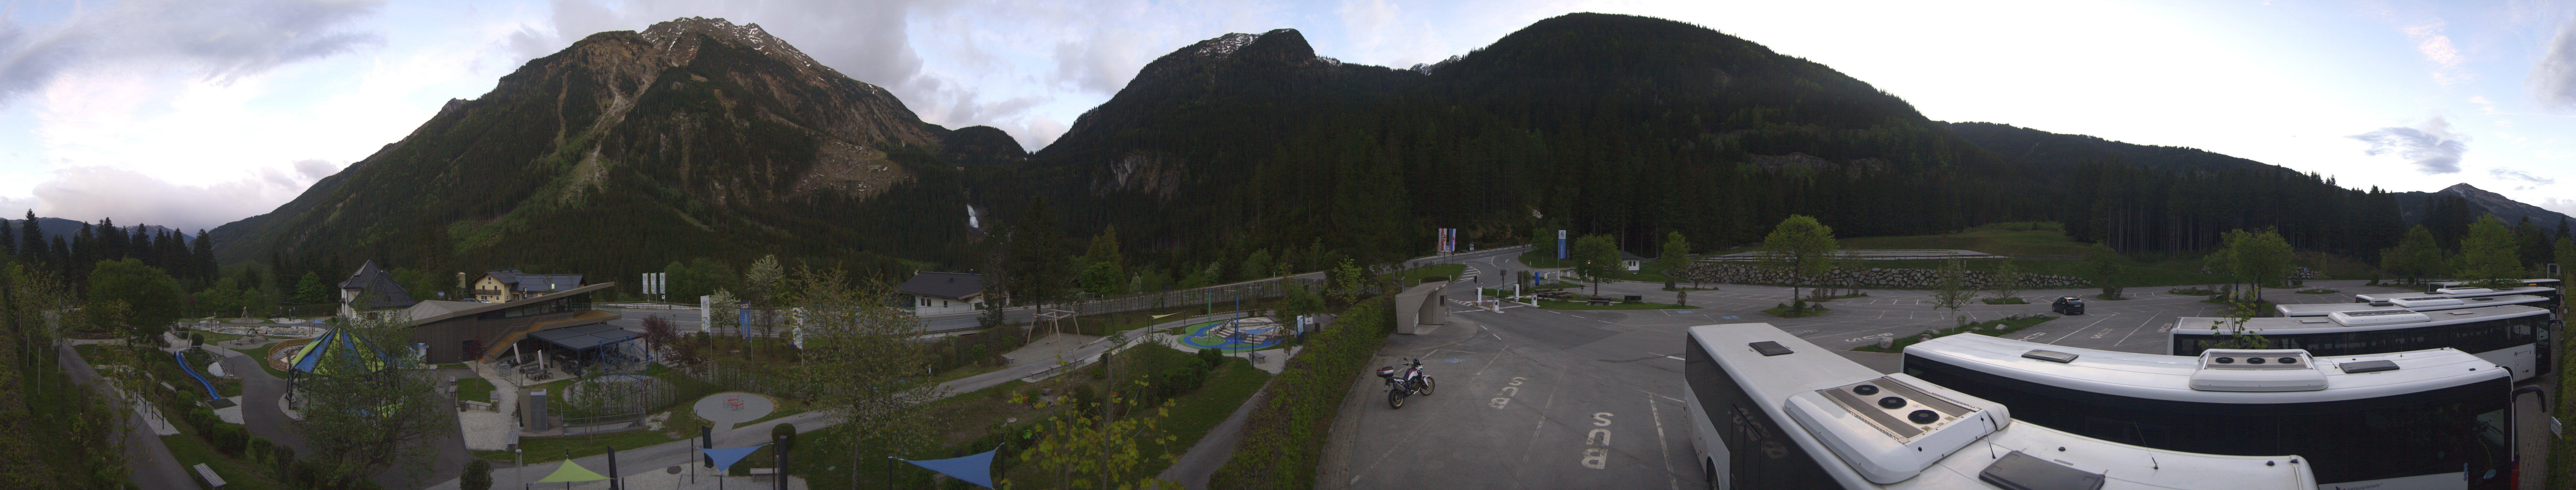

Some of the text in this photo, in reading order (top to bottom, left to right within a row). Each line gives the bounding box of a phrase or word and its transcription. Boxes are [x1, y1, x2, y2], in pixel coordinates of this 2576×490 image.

[1845, 333, 1893, 342] BUS
[1488, 376, 1527, 409] BUS
[1581, 412, 1614, 469] BUS
